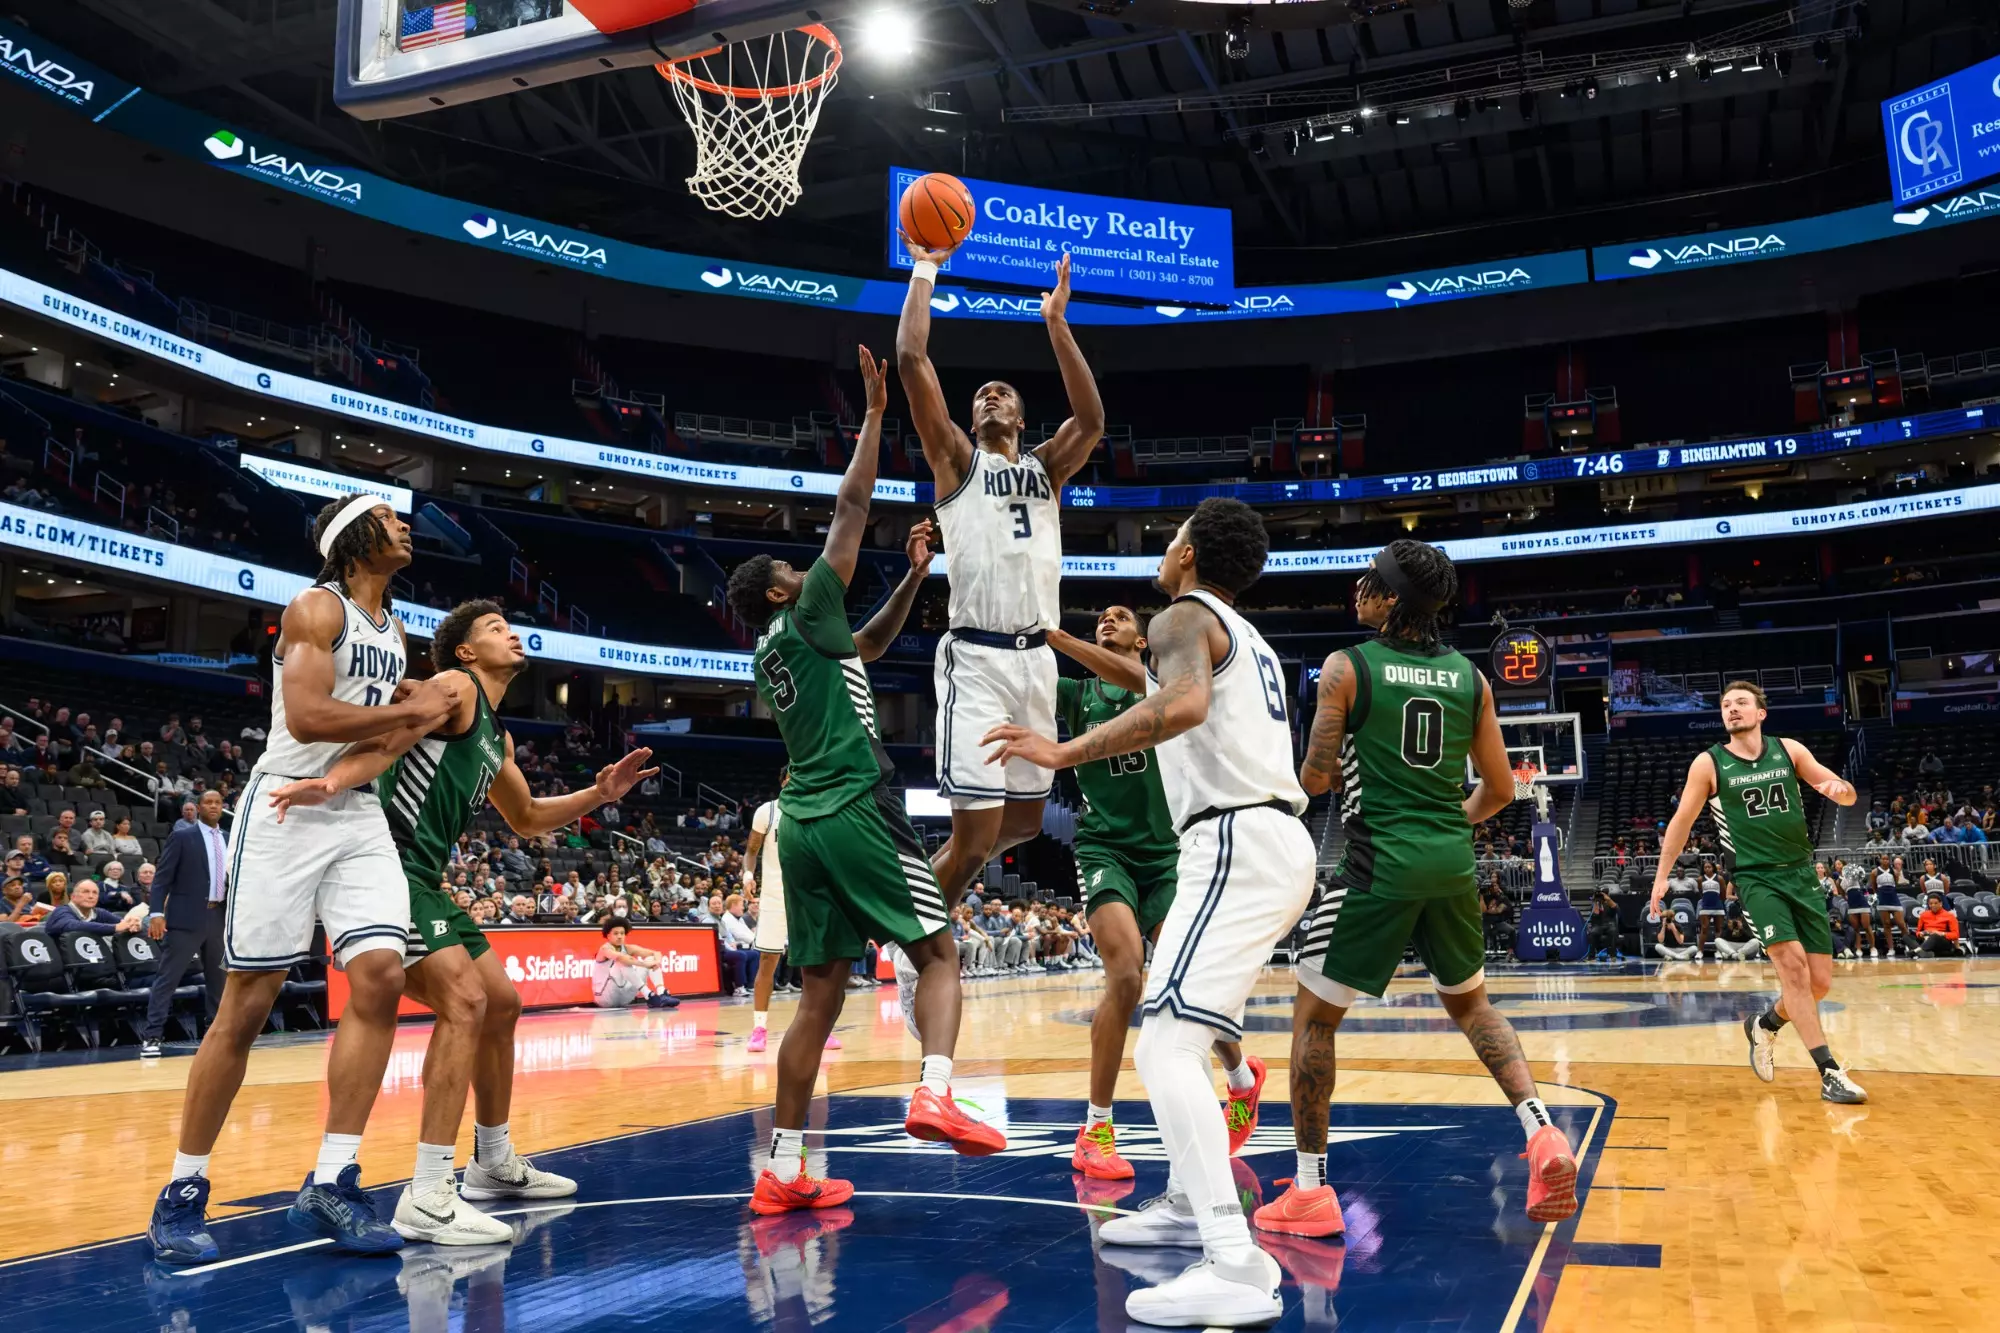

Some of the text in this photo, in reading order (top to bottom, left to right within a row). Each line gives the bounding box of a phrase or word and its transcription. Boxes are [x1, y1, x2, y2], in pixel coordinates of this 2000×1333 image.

[0, 35, 95, 100] ANDA
[1893, 86, 1947, 112] COAKLEY
[249, 145, 362, 200] VANDA
[1905, 173, 1959, 198] REALTY
[984, 196, 1194, 248] Coakley Realty
[502, 223, 607, 264] VANDA
[1044, 239, 1058, 252] &
[1061, 240, 1142, 262] Commercial
[1146, 250, 1176, 265] Real
[1179, 253, 1220, 269] Estate
[1663, 234, 1786, 261] VANDA
[736, 271, 839, 298] VANDA
[1128, 269, 1156, 283] (301)
[1159, 272, 1179, 284] 340
[1188, 275, 1214, 287] 8700
[1417, 267, 1532, 293] VANDA
[962, 295, 1045, 313] VAND
[42, 294, 203, 364] GUHOYAS.COM/TICKETS
[256, 372, 272, 389] G
[331, 393, 475, 440] GUHOYAS.COM/TICKETS
[531, 438, 545, 453] G
[1845, 437, 1851, 447] 7
[1905, 428, 1911, 438] 3
[1680, 441, 1766, 464] BINGHAMTON
[1774, 438, 1797, 455] 19
[599, 451, 738, 480] GUHOYAS.COM/TICKETS
[1411, 475, 1433, 491] 22
[1437, 465, 1518, 488] GEORGETOWN
[1573, 453, 1624, 477] 7:46
[790, 474, 804, 488] G
[984, 467, 1050, 501] HOYAS
[1334, 489, 1340, 497] 3
[1392, 484, 1399, 492] 5
[1010, 503, 1032, 540] 3
[1792, 494, 1963, 527] GUHOYAS.COM/TICKETS
[1501, 528, 1656, 551] GUHOYAS.COM/TICKETS
[1716, 520, 1731, 535] G
[1, 515, 164, 567] AS.COM/TICKETS
[238, 569, 254, 591] G
[528, 634, 542, 651] G
[1015, 635, 1028, 650] G
[1509, 639, 1539, 655] 7:46
[1384, 664, 1460, 689] QUIGLEY
[1504, 654, 1537, 680] 22
[760, 648, 798, 713] 5
[1251, 646, 1287, 722] 13
[1401, 697, 1444, 769] 0
[1729, 768, 1788, 787] BINGHAMTON
[1742, 782, 1790, 819] 24
[430, 920, 450, 939] B
[1763, 924, 1775, 941] B
[20, 938, 51, 964] G
[75, 936, 104, 960] G
[127, 936, 154, 961] G
